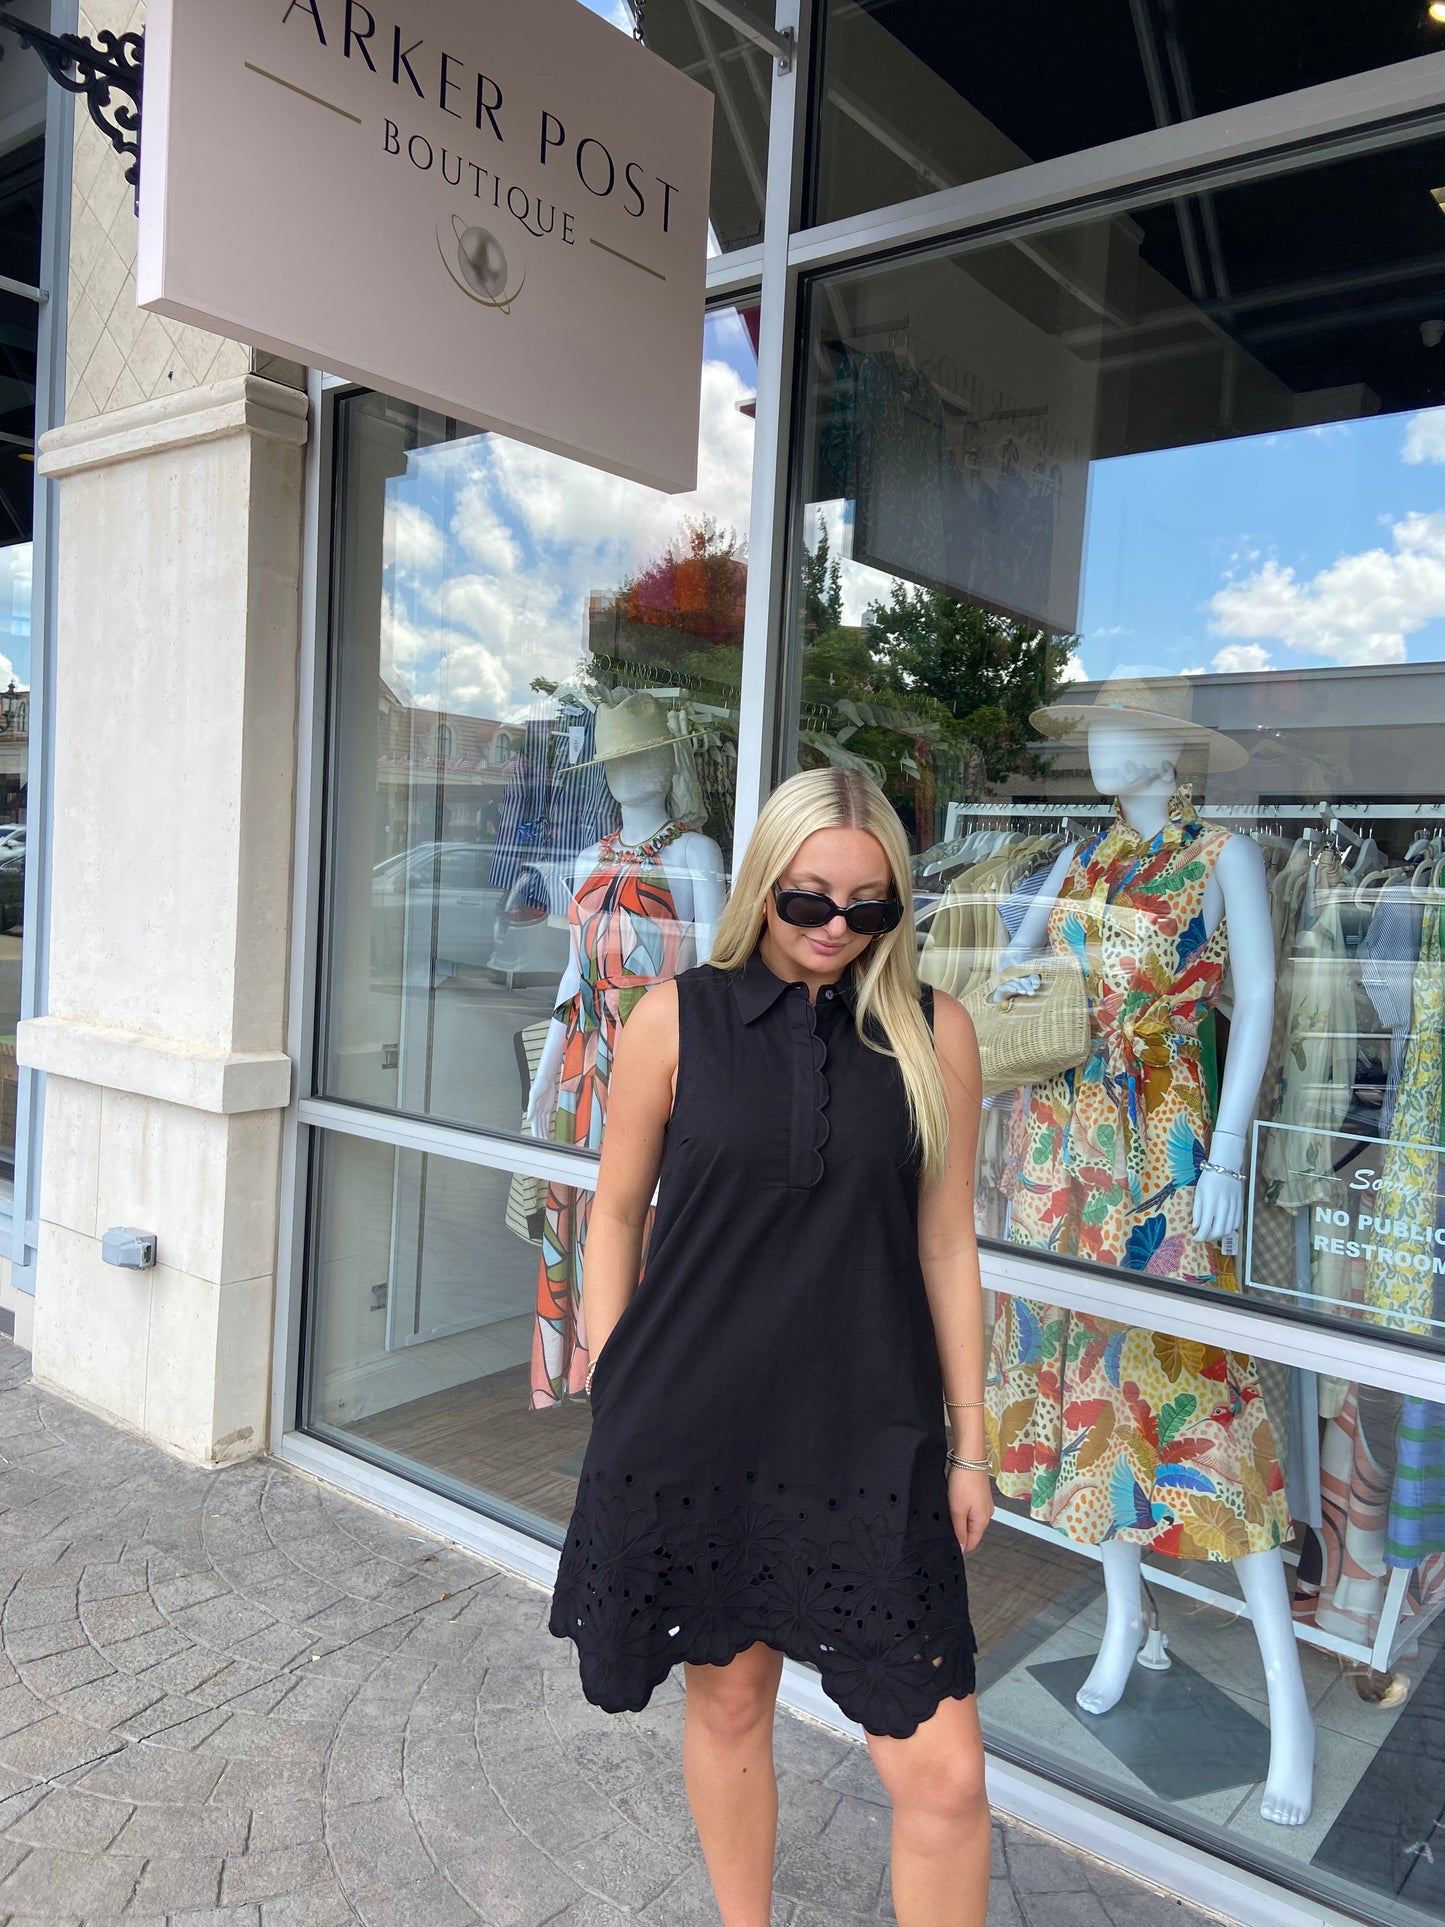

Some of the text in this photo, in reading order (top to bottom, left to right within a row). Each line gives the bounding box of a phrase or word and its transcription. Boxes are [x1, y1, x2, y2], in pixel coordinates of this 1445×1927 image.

[382, 117, 576, 246] BOUTIQUE
[539, 110, 680, 234] POST
[1349, 1169, 1420, 1202] Sorry
[1315, 1206, 1445, 1246] NO PUBLIC
[1313, 1235, 1445, 1275] RESTROOM
